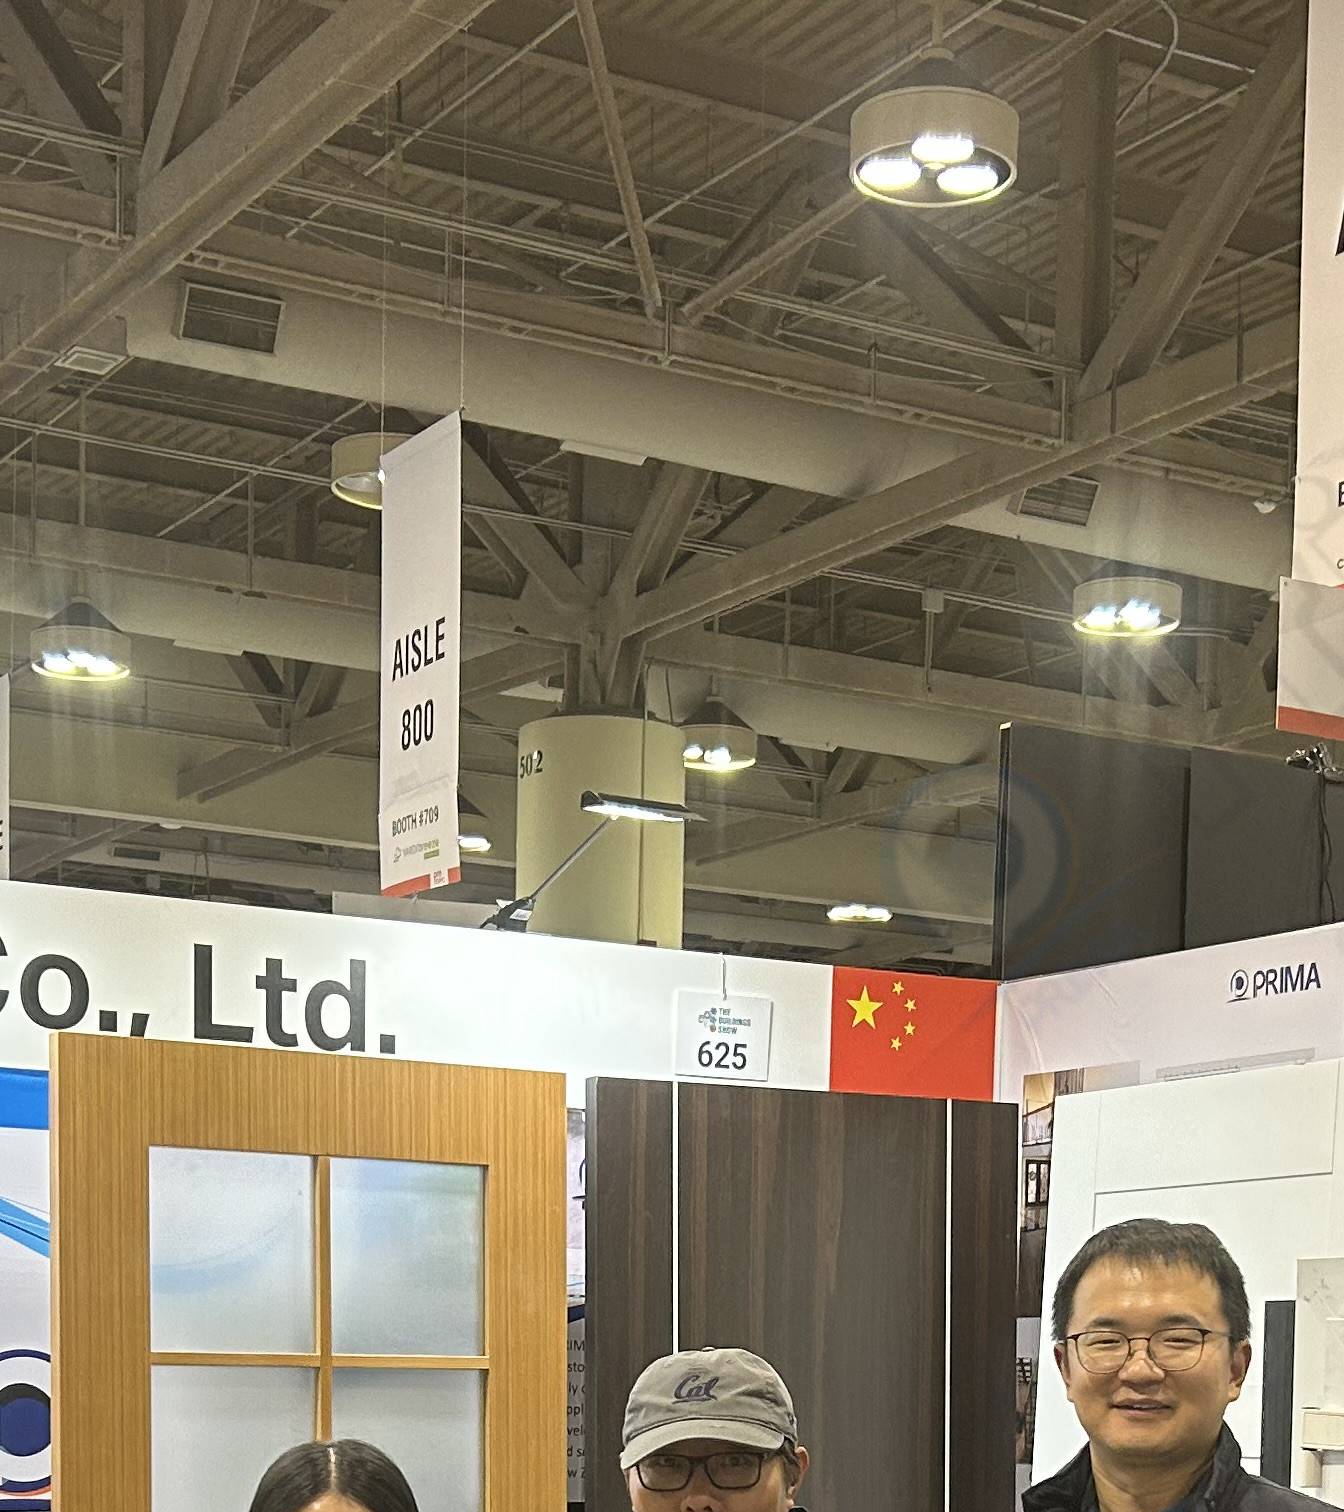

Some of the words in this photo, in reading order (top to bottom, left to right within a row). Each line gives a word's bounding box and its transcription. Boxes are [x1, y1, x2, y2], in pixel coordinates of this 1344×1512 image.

[392, 616, 446, 682] AISLE
[401, 699, 434, 751] 800
[519, 750, 543, 779] 502
[391, 812, 417, 837] BOOTH
[418, 805, 439, 827] #709
[1253, 962, 1322, 998] PRIMA
[193, 944, 396, 1055] Ltd.
[698, 1041, 747, 1070] 625
